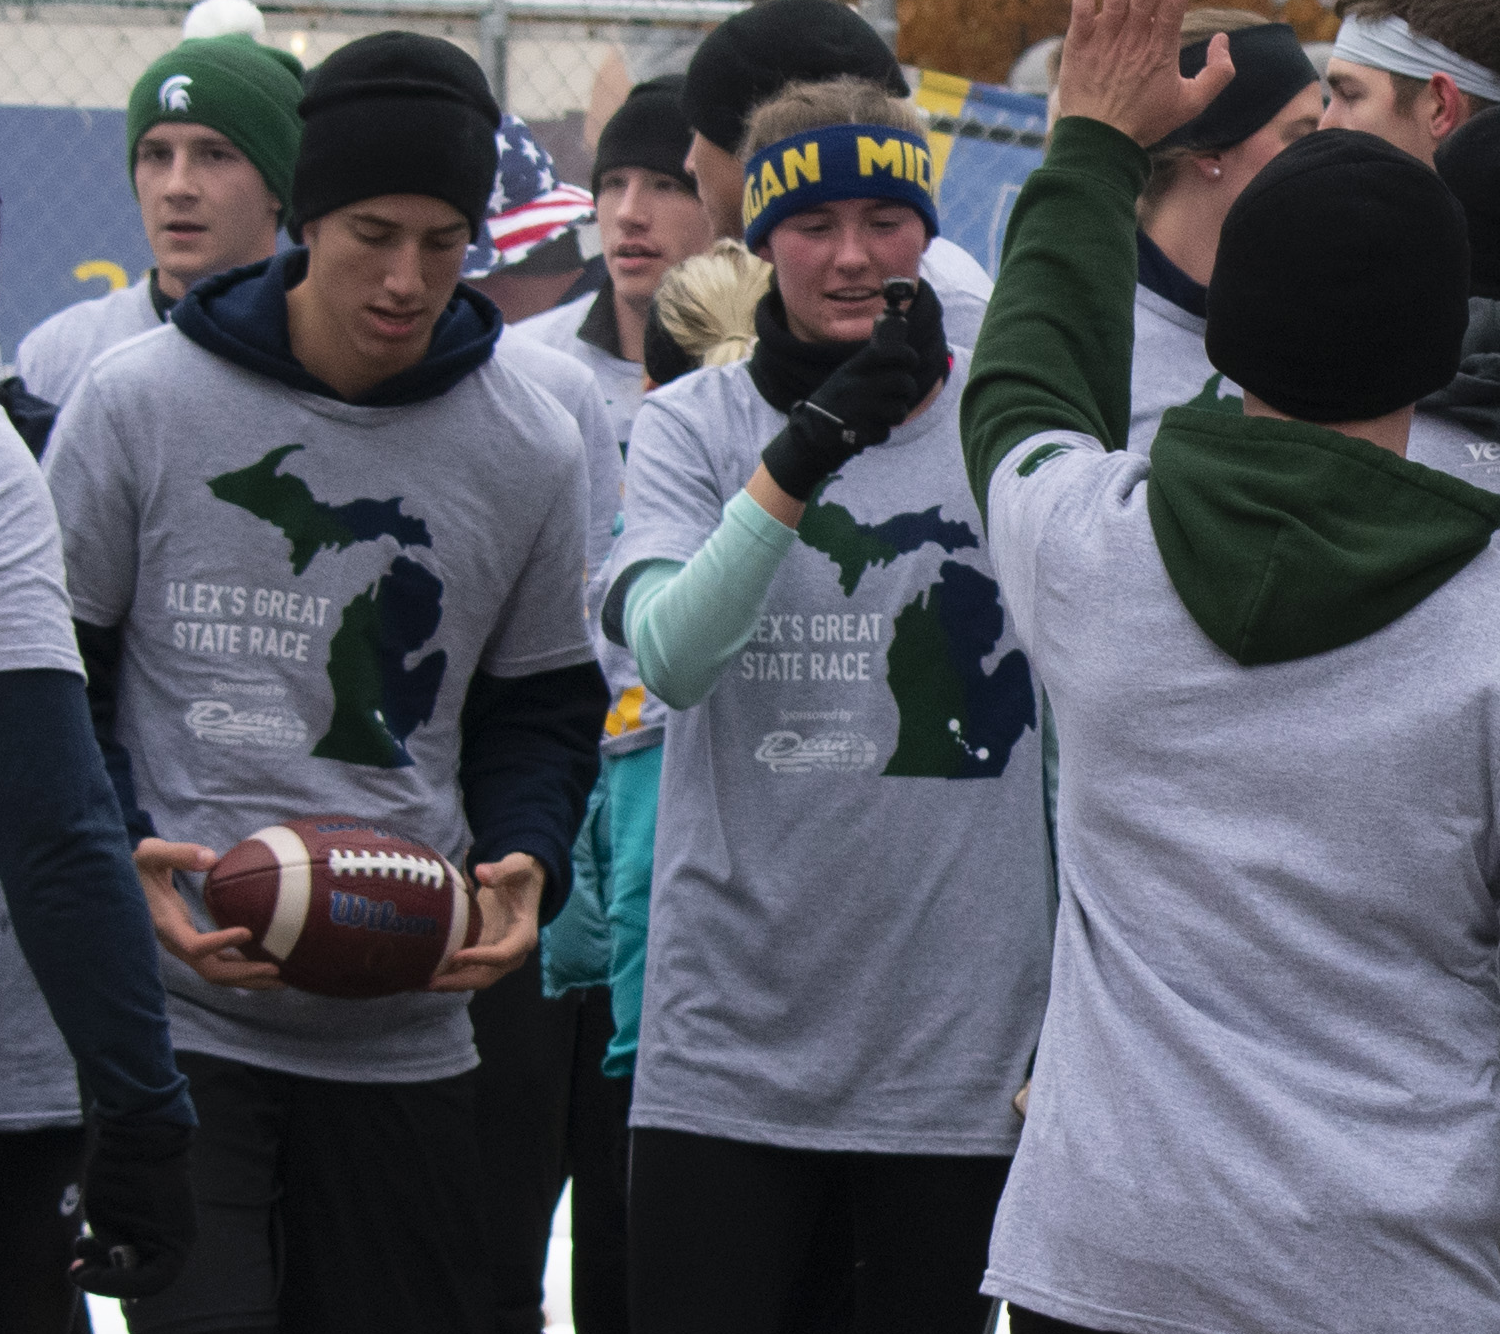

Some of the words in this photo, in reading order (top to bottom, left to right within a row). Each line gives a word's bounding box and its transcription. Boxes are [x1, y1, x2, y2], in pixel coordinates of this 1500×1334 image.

[166, 582, 248, 616] ALEX'S
[254, 588, 332, 627] GREAT
[173, 620, 243, 654] STATE
[249, 625, 312, 663] RACE
[811, 613, 884, 643] GREAT
[741, 651, 804, 682] STATE
[811, 651, 871, 682] RACE
